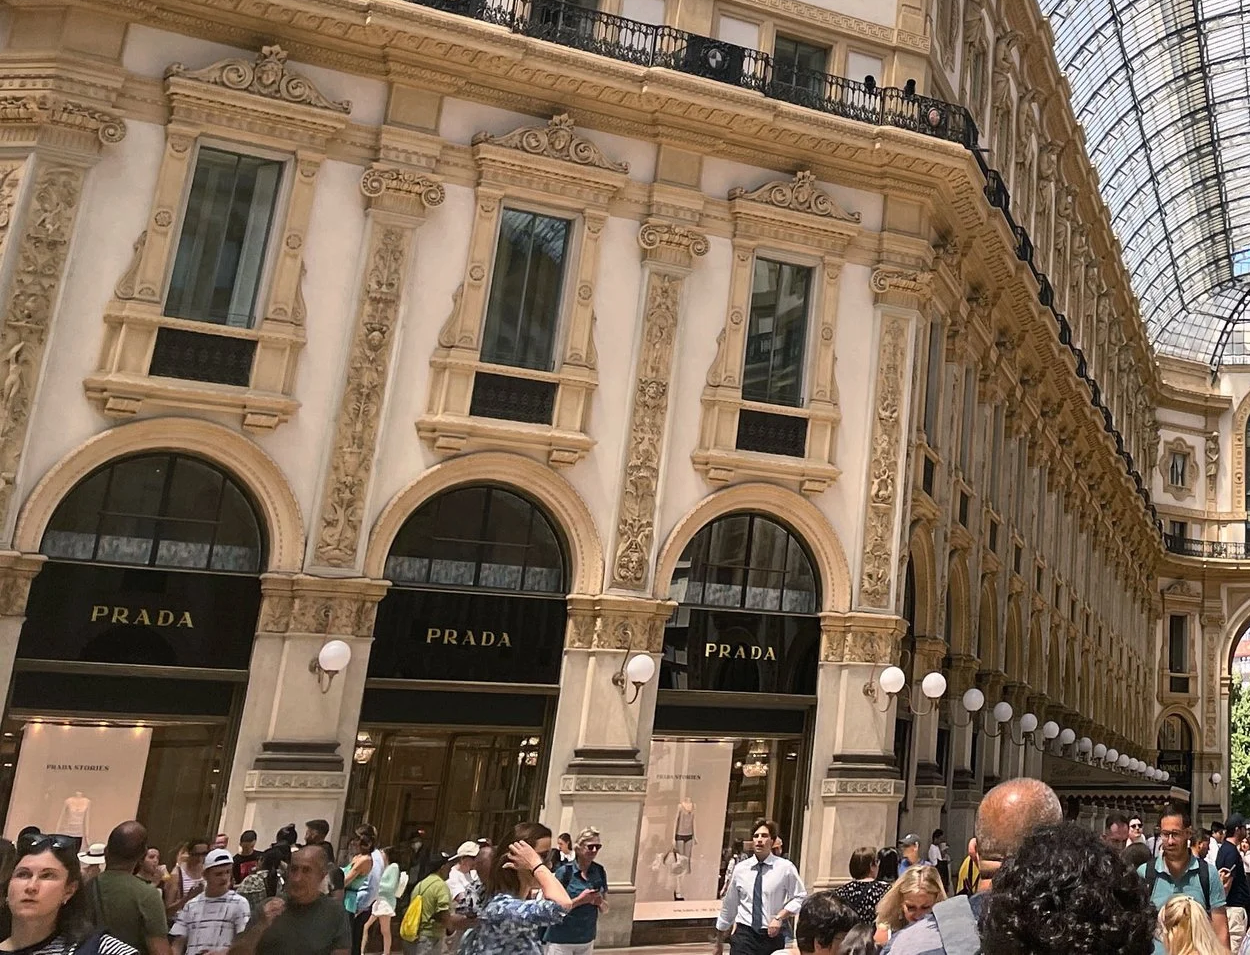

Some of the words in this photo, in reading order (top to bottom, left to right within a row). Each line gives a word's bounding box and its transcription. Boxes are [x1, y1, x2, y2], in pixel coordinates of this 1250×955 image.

[91, 605, 194, 629] PRADA
[426, 628, 512, 647] PRADA
[705, 643, 776, 661] PRADA
